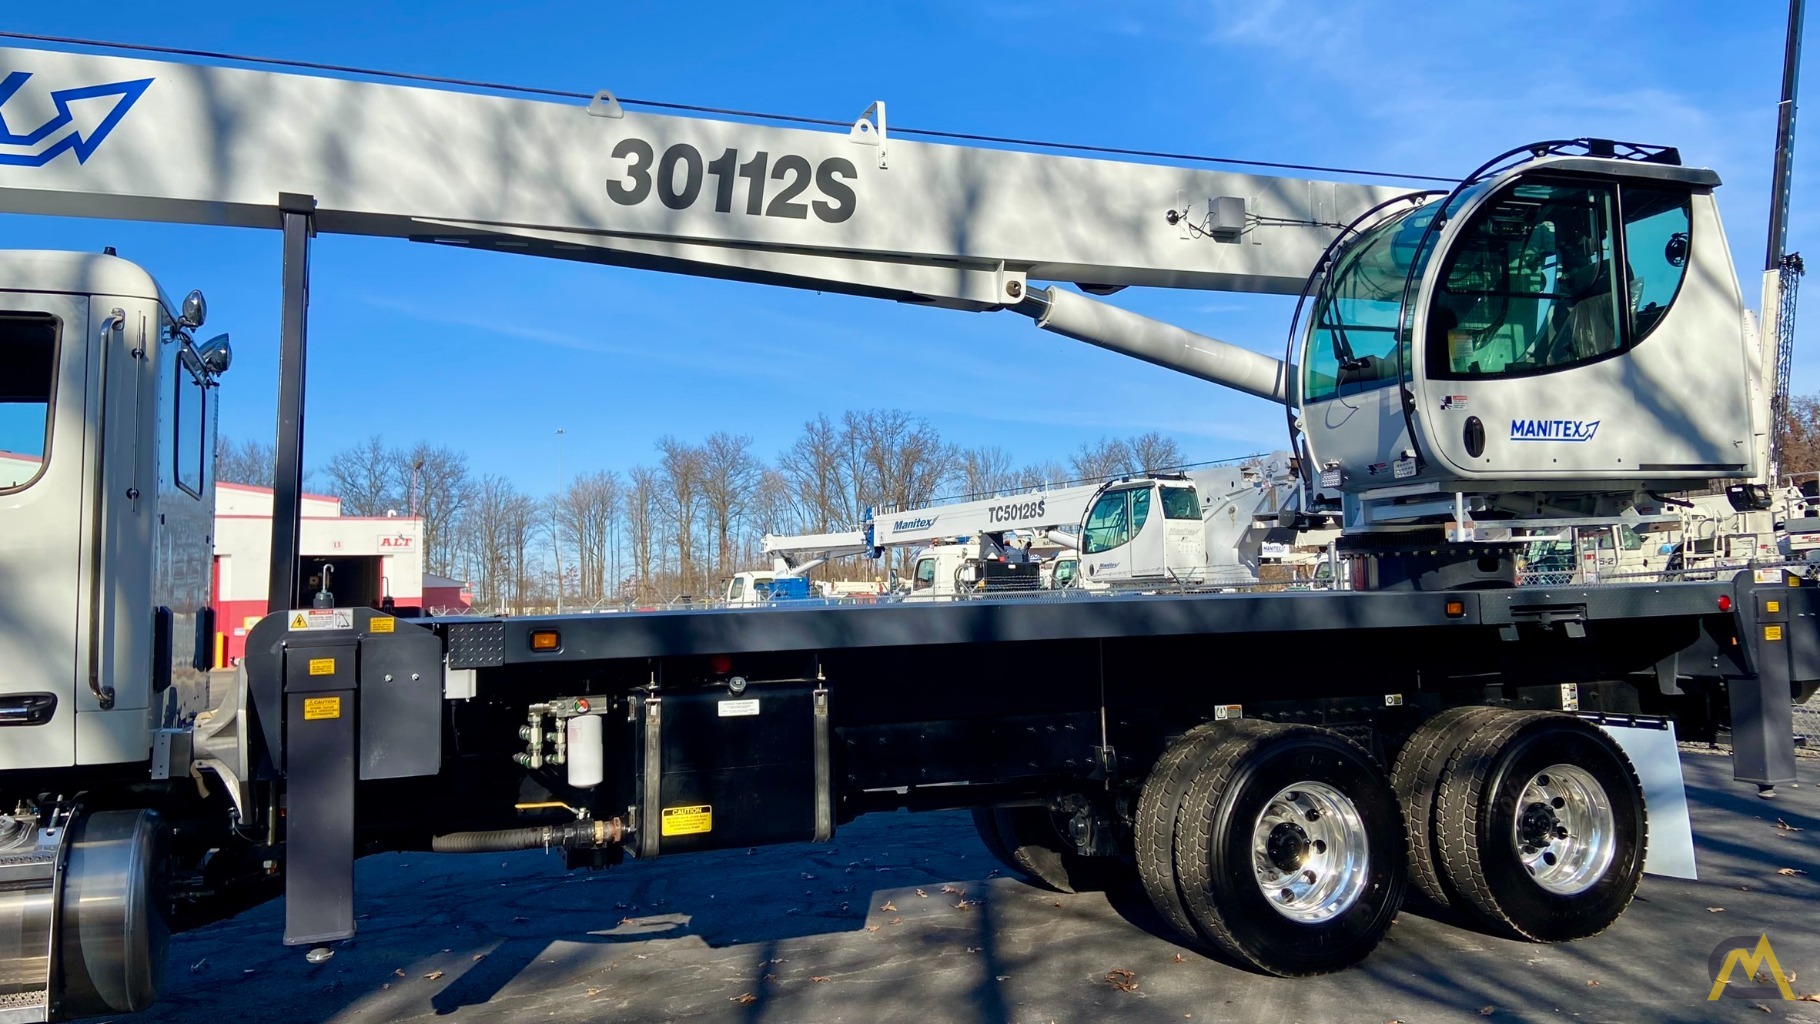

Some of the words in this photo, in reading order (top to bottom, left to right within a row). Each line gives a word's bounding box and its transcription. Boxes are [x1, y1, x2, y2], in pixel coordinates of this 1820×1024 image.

[606, 138, 858, 223] 30112S
[1511, 419, 1586, 438] MANITEX
[989, 500, 1045, 523] TC50128S
[893, 516, 934, 531] Manitex
[380, 537, 413, 547] ALT
[672, 807, 702, 816] CAUTION
